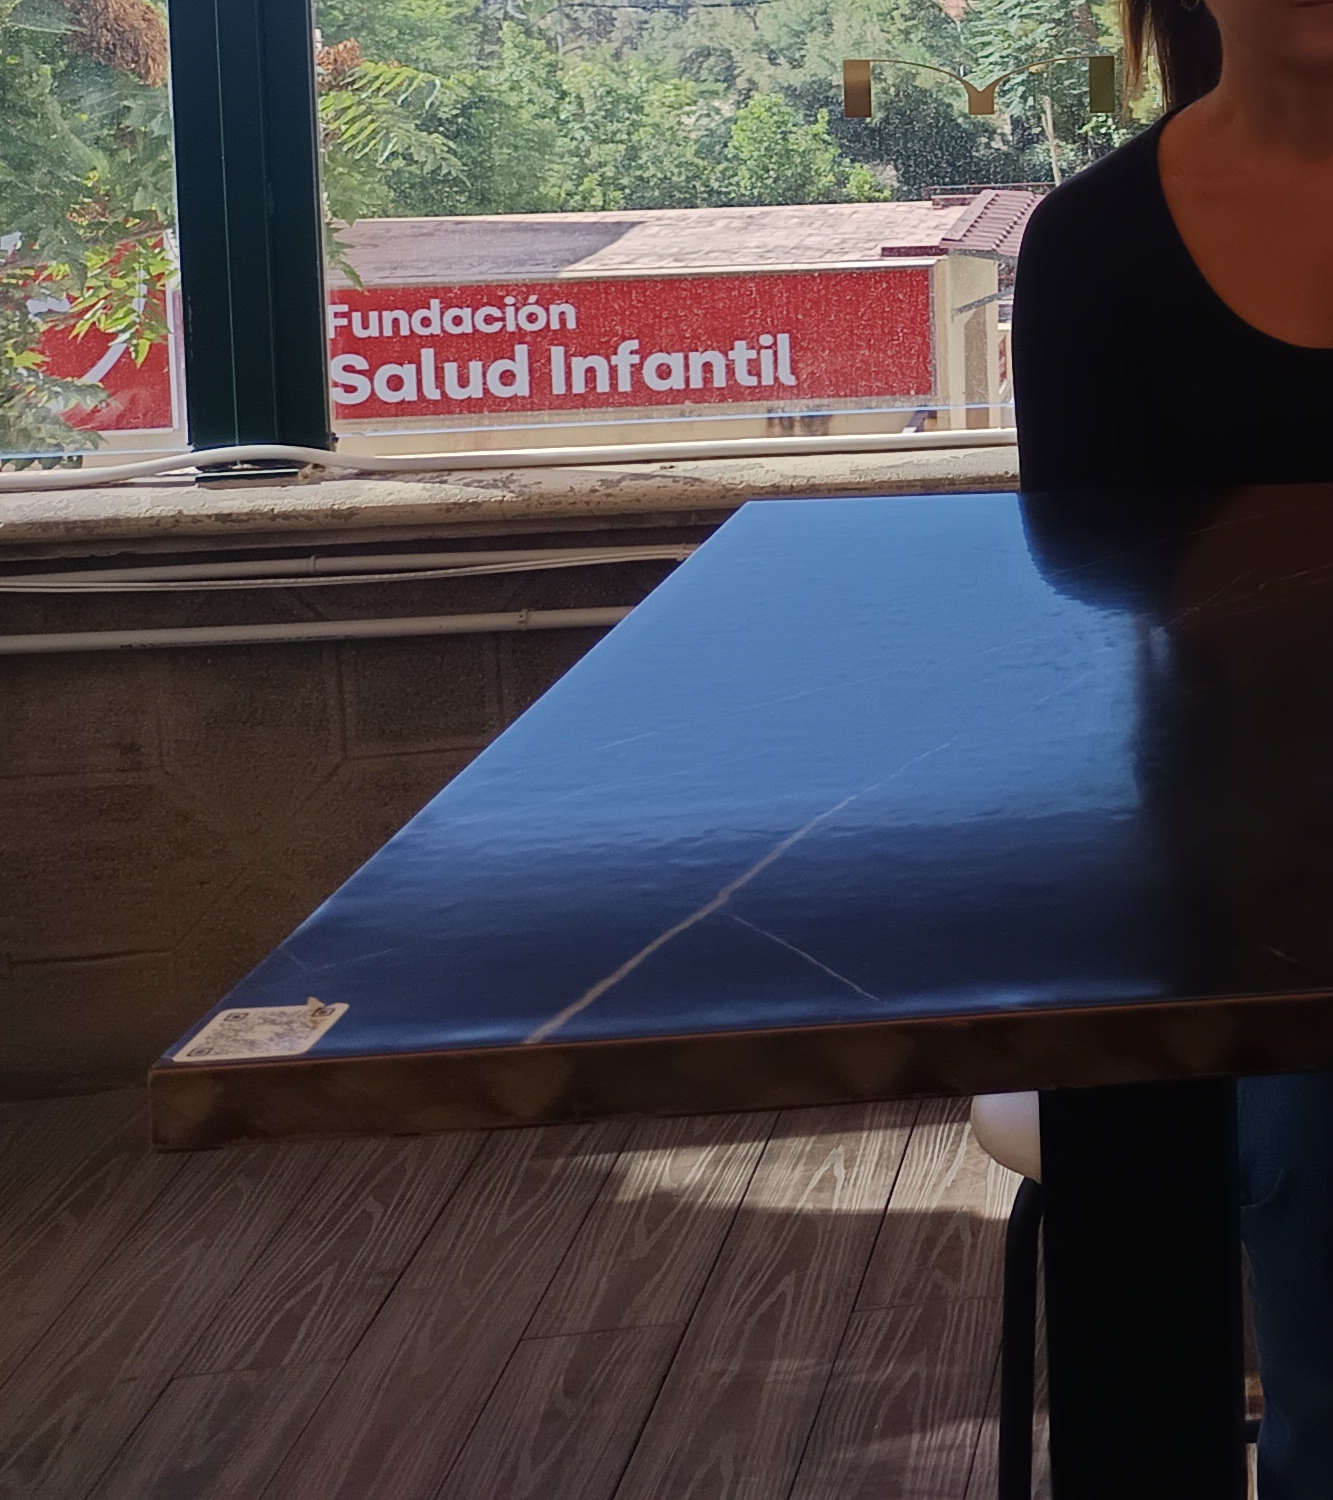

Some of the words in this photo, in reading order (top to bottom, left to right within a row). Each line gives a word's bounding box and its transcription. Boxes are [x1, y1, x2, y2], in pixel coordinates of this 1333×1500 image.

[328, 295, 577, 340] Fundación
[330, 344, 530, 406] Salud
[550, 333, 796, 395] Infantil
